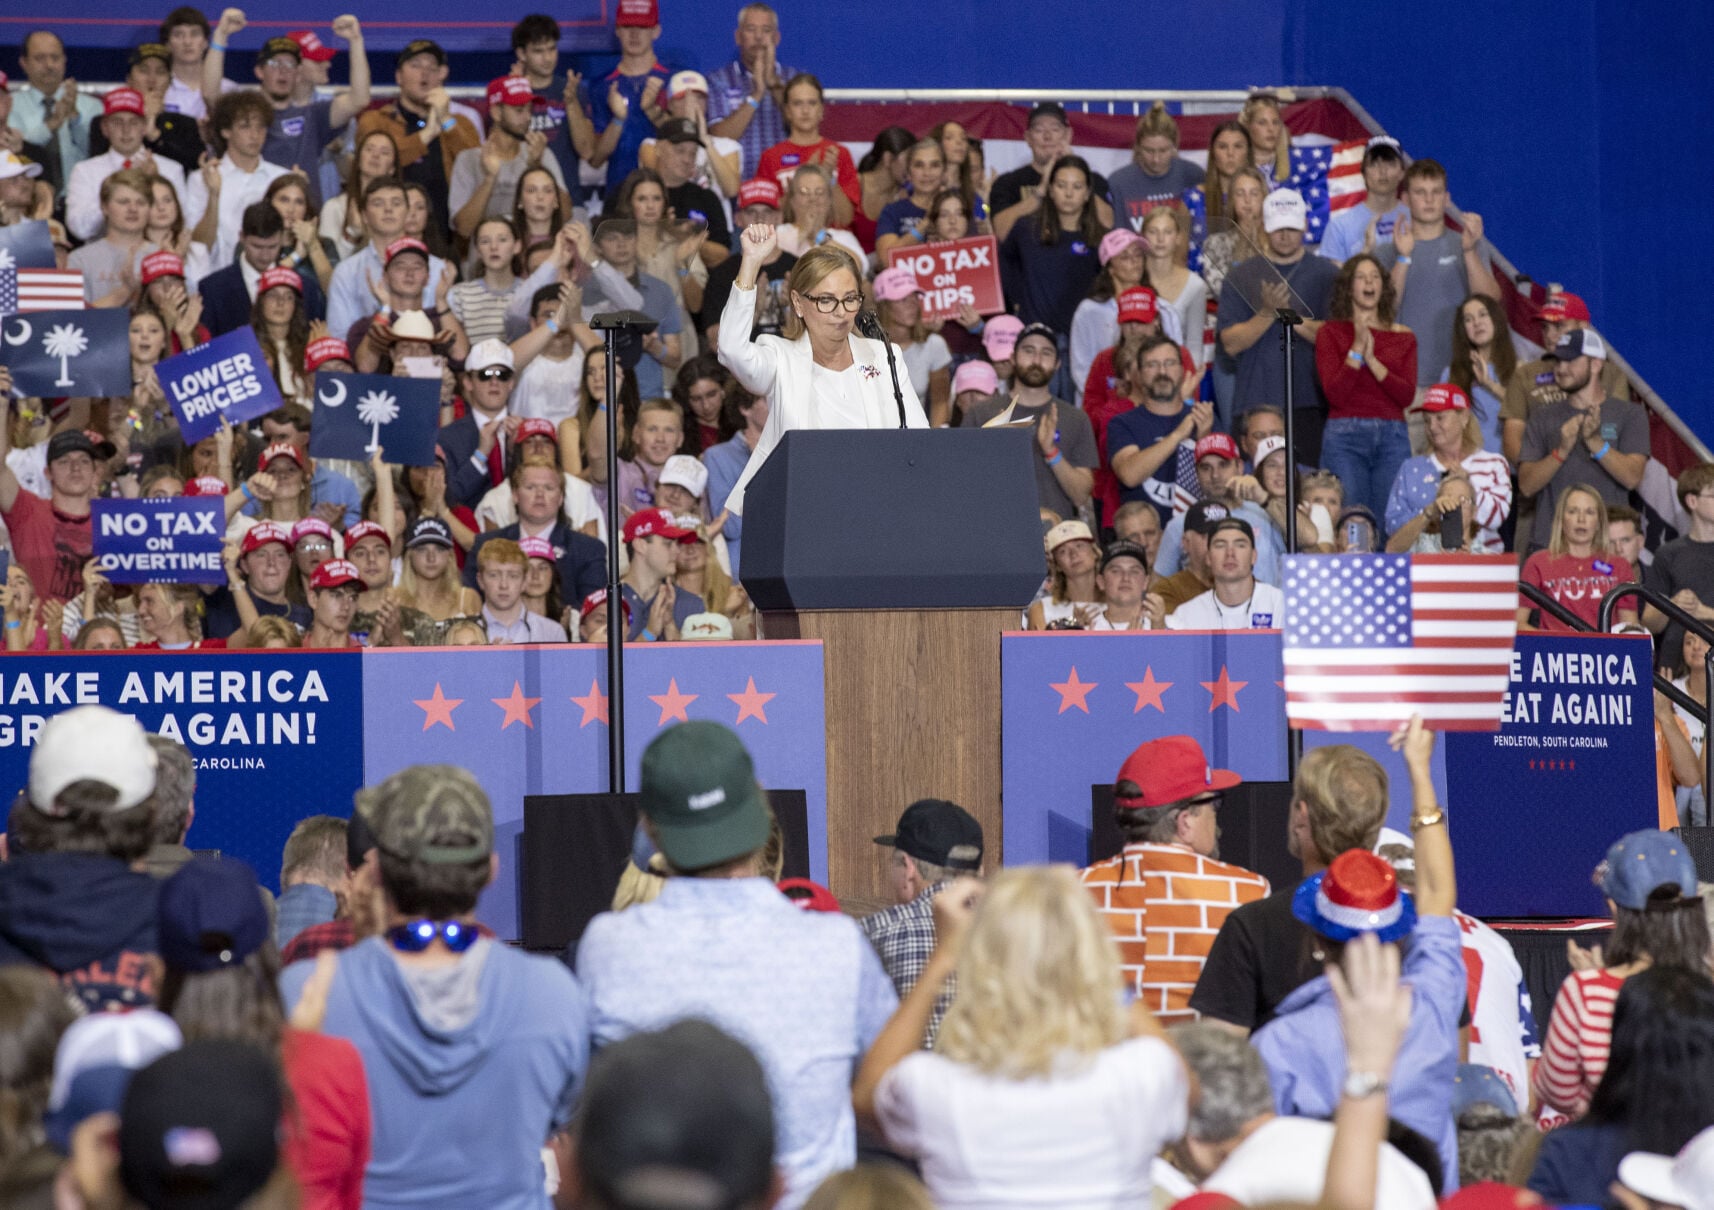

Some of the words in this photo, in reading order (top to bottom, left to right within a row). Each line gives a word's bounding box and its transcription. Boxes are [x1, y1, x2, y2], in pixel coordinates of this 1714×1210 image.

[896, 255, 935, 276] NO
[939, 246, 991, 272] TAX
[933, 273, 957, 288] ON
[918, 285, 975, 312] TIPS
[170, 353, 255, 402] LOWER
[181, 375, 262, 423] PRICES
[101, 513, 148, 536] NO
[155, 512, 217, 536] TAX
[146, 537, 173, 551] ON
[102, 552, 221, 571] OVERTIME
[1532, 652, 1637, 685] AMERICA
[0, 672, 99, 705] AKE
[118, 669, 329, 704] AMERICA
[1551, 693, 1632, 725] AGAIN!
[158, 712, 317, 746] AGAIN!
[1494, 735, 1541, 748] PENDLETON,
[1542, 736, 1568, 747] SOUTH
[1569, 736, 1608, 748] CAROLINA
[192, 758, 266, 770] CAROLINA
